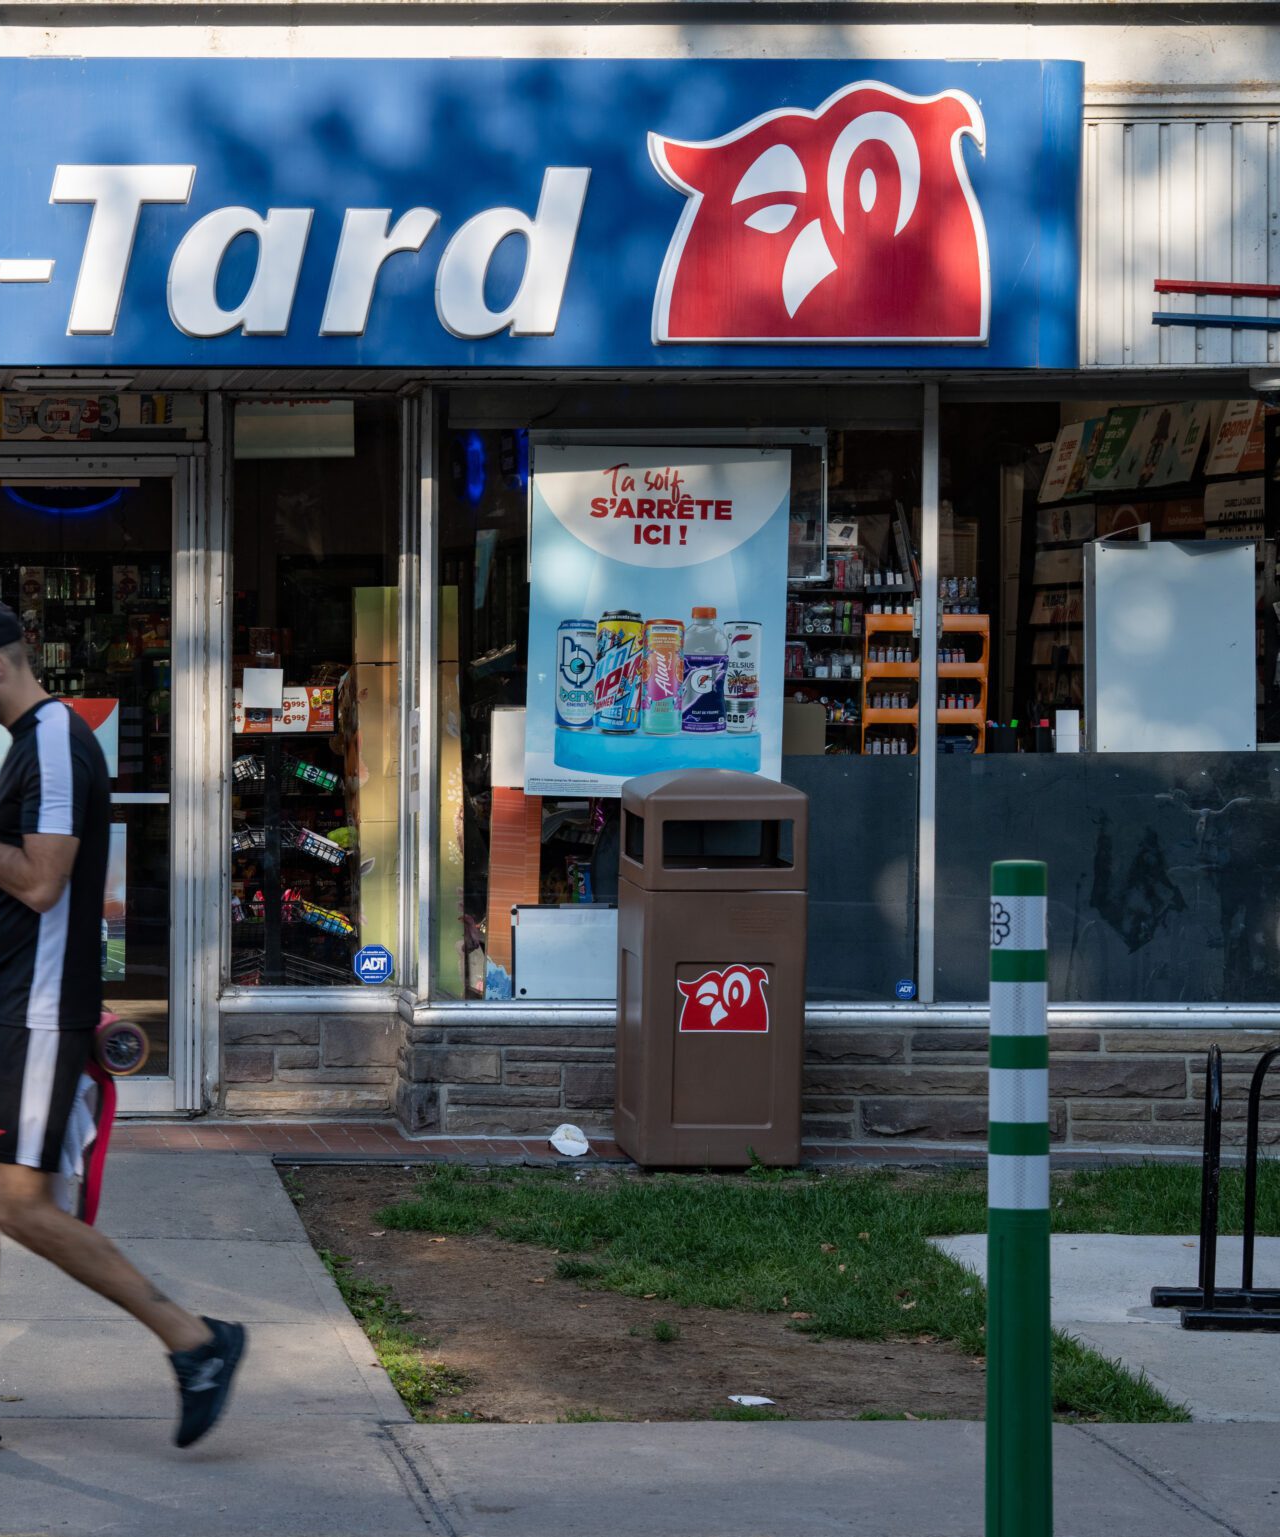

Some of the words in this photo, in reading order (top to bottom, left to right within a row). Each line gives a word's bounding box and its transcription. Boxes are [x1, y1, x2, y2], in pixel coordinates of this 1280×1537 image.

[603, 463, 636, 496] Ta
[644, 466, 684, 504] soif
[633, 524, 671, 546] ICI
[559, 685, 595, 705] bang
[361, 957, 388, 971] ADT
[898, 985, 913, 993] ADT
